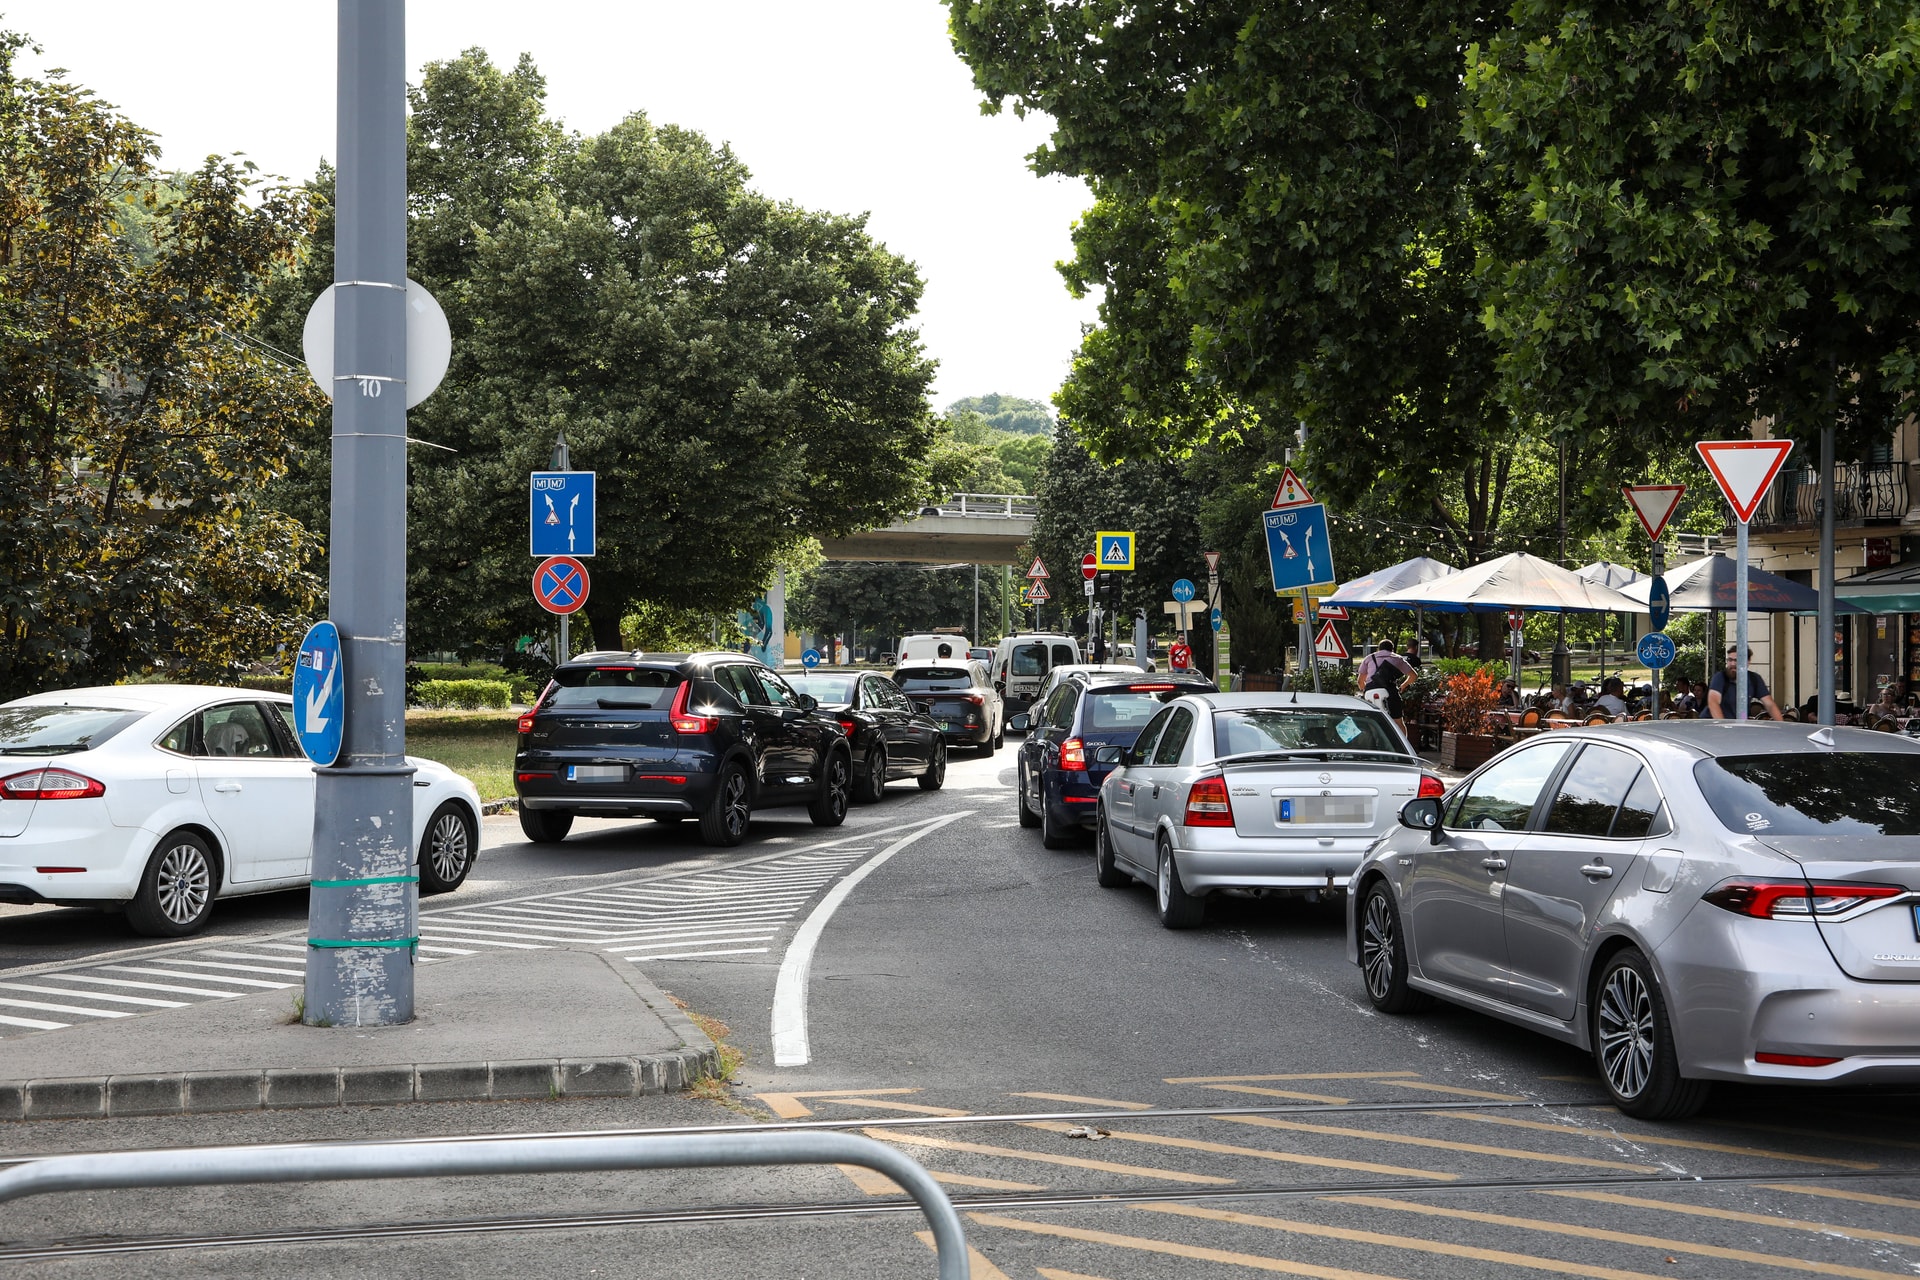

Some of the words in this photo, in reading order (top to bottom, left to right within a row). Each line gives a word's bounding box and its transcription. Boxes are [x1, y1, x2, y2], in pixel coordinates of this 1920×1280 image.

[358, 379, 381, 397] 10
[536, 480, 546, 488] M1
[551, 480, 562, 488] M7
[1269, 517, 1279, 526] M1
[1283, 514, 1294, 524] M7
[1755, 592, 1792, 602] Bull
